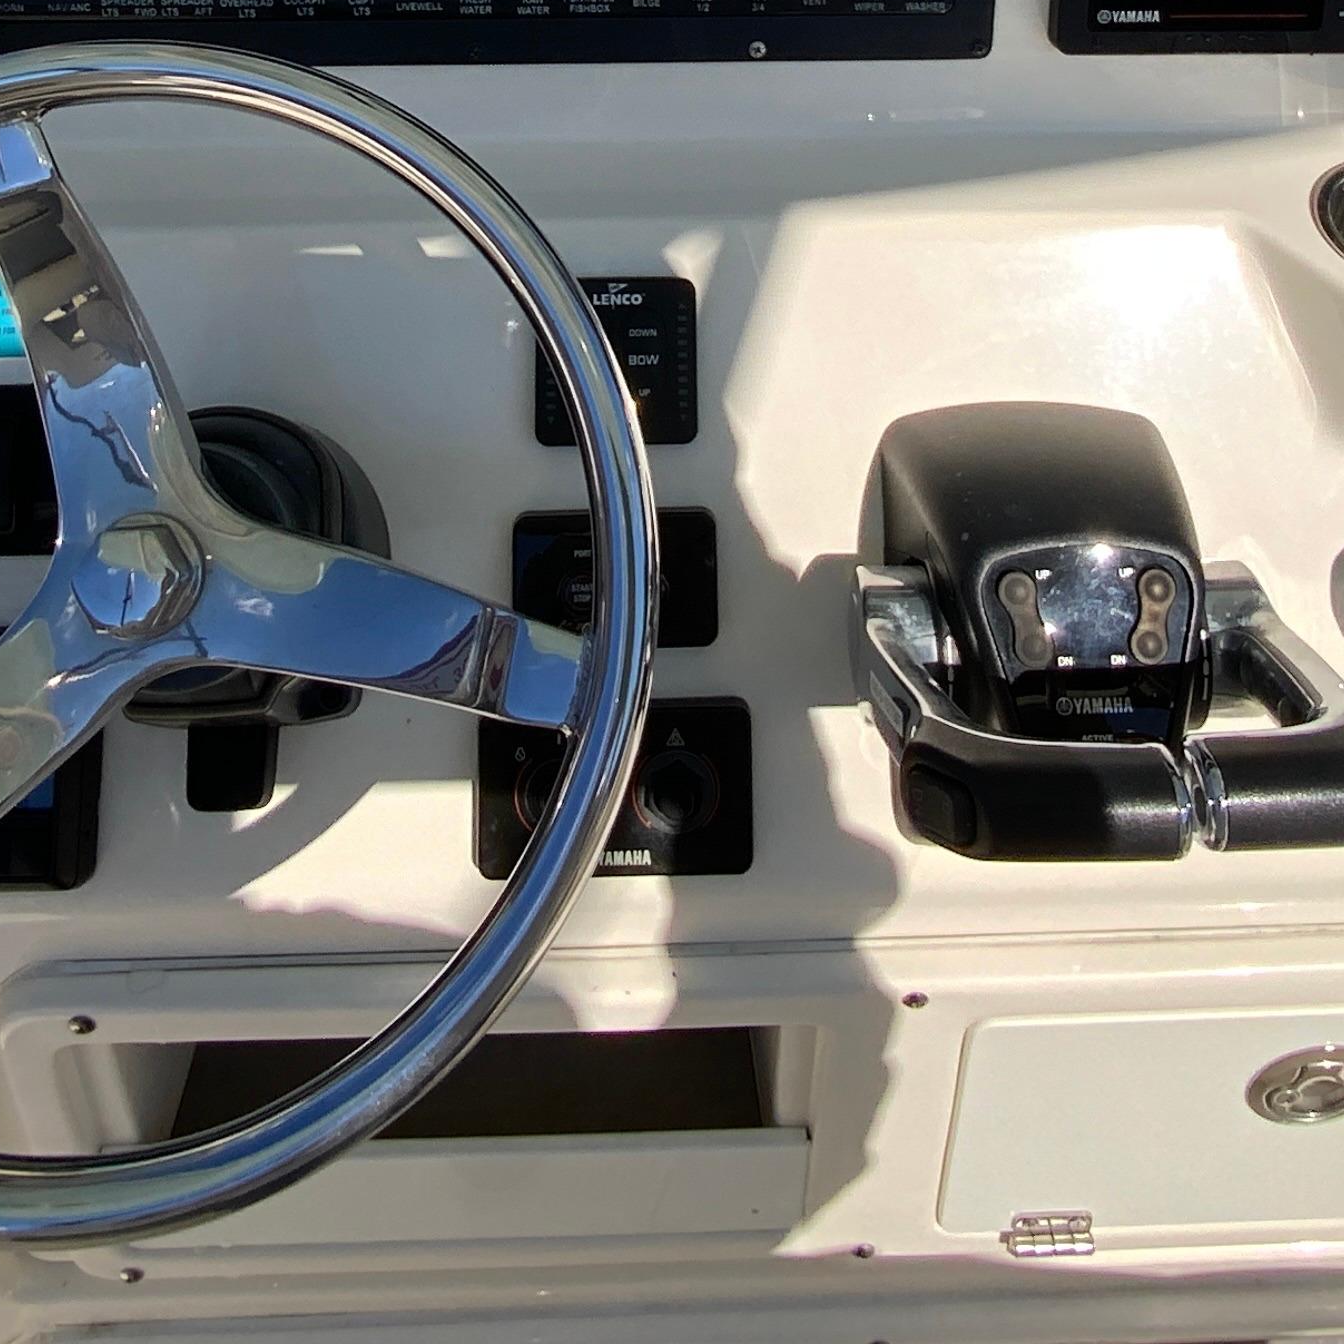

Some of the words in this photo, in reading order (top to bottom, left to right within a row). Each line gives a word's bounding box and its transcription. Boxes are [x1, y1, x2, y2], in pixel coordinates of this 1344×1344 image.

[297, 7, 314, 16] LTS
[354, 7, 371, 16] LTS
[459, 5, 492, 15] WATER
[517, 5, 550, 15] WATER
[569, 4, 610, 13] FISHBOX
[854, 2, 885, 11] WIPER
[102, 9, 119, 17] LTS
[162, 8, 179, 17] LTS
[194, 7, 212, 16] AFT
[238, 9, 256, 18] LTS
[1112, 10, 1160, 23] YAMAHA
[593, 294, 643, 306] LENCO
[628, 328, 657, 337] DOWN
[628, 355, 659, 366] BOW
[638, 388, 650, 397] UP
[1035, 569, 1052, 579] UP
[1118, 567, 1135, 578] UP
[1057, 656, 1073, 666] DN
[1110, 655, 1127, 665] DN
[1073, 697, 1134, 714] YAMAHA
[1082, 734, 1113, 742] ACTIVE
